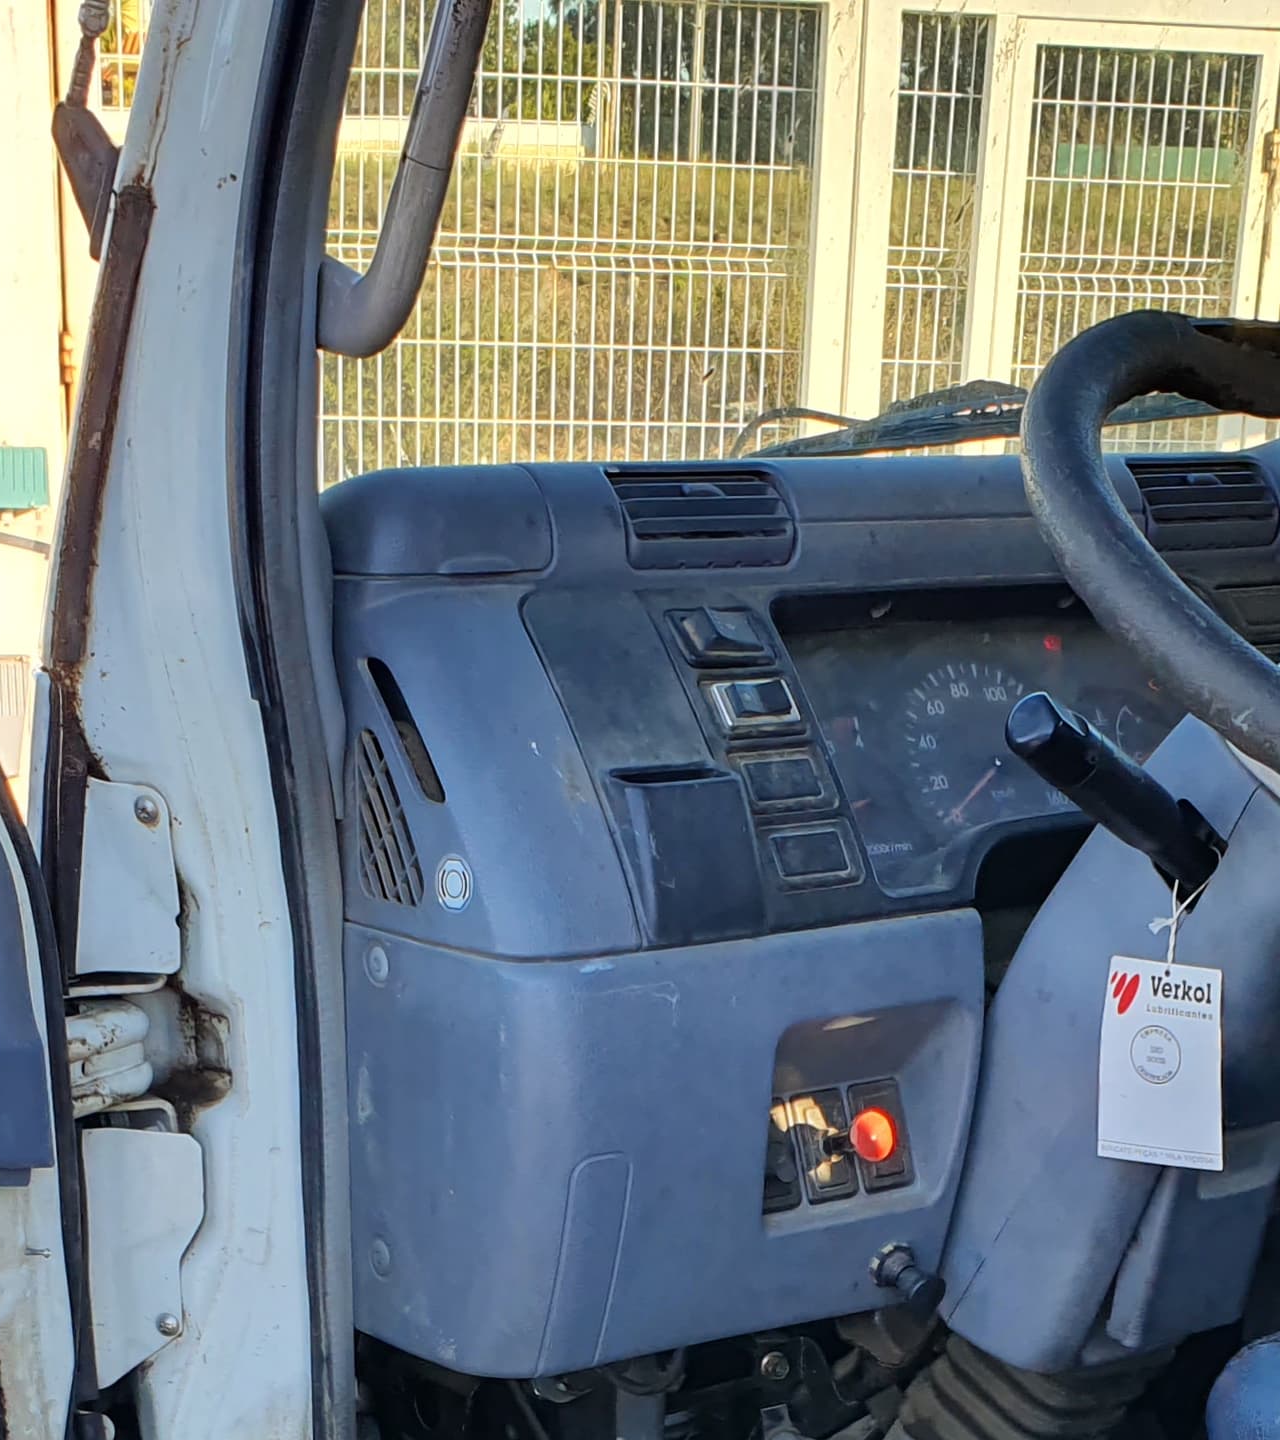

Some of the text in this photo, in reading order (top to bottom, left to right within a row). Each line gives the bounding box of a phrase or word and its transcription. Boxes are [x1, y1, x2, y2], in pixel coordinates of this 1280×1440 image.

[949, 682, 970, 698] 80
[982, 686, 1008, 702] 100
[926, 700, 945, 716] 60
[918, 735, 937, 750] 40
[929, 775, 949, 790] 20
[1150, 975, 1212, 1005] Verkol
[1146, 1004, 1214, 1021] Lubrificantes
